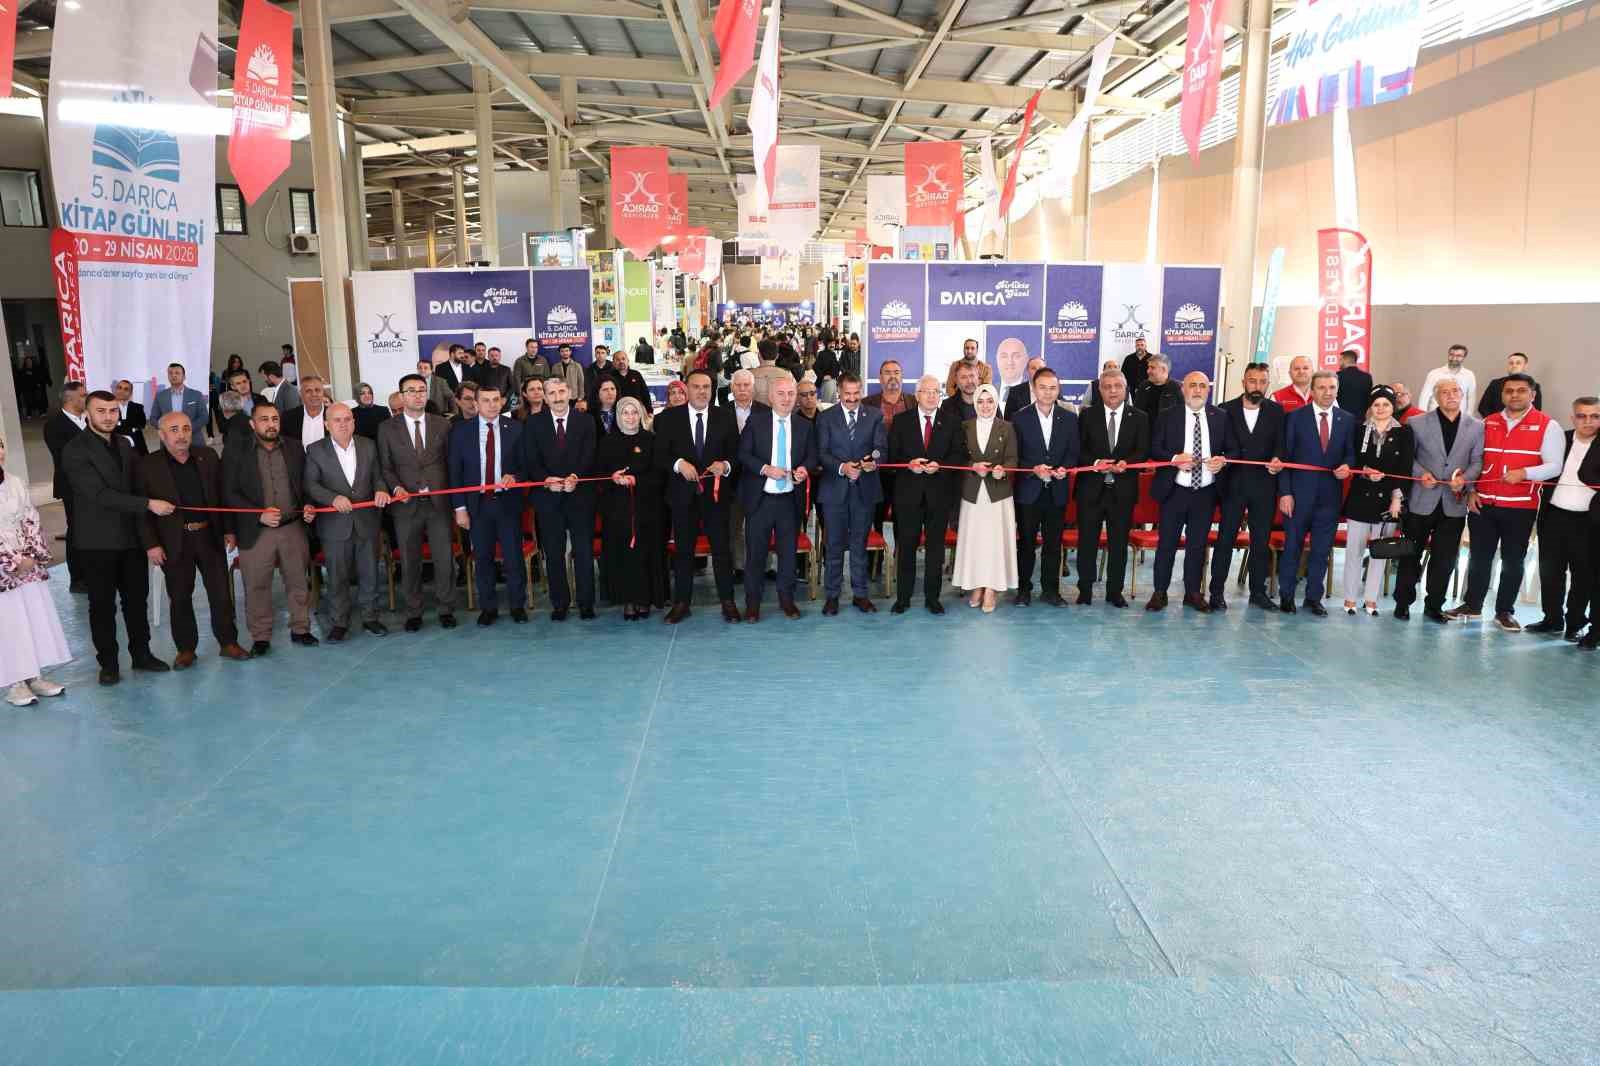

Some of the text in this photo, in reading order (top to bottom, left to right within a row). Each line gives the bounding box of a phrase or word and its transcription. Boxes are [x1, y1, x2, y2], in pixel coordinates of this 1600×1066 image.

[91, 174, 179, 212] 5. DARICA
[61, 197, 204, 244] KİTAP GÜNLERİ
[104, 239, 117, 257] 29
[120, 239, 163, 260] NİSAN
[166, 244, 194, 263] 2026
[429, 299, 494, 314] DARICA
[940, 291, 1006, 306] DARICA
[1115, 331, 1145, 339] DARICA
